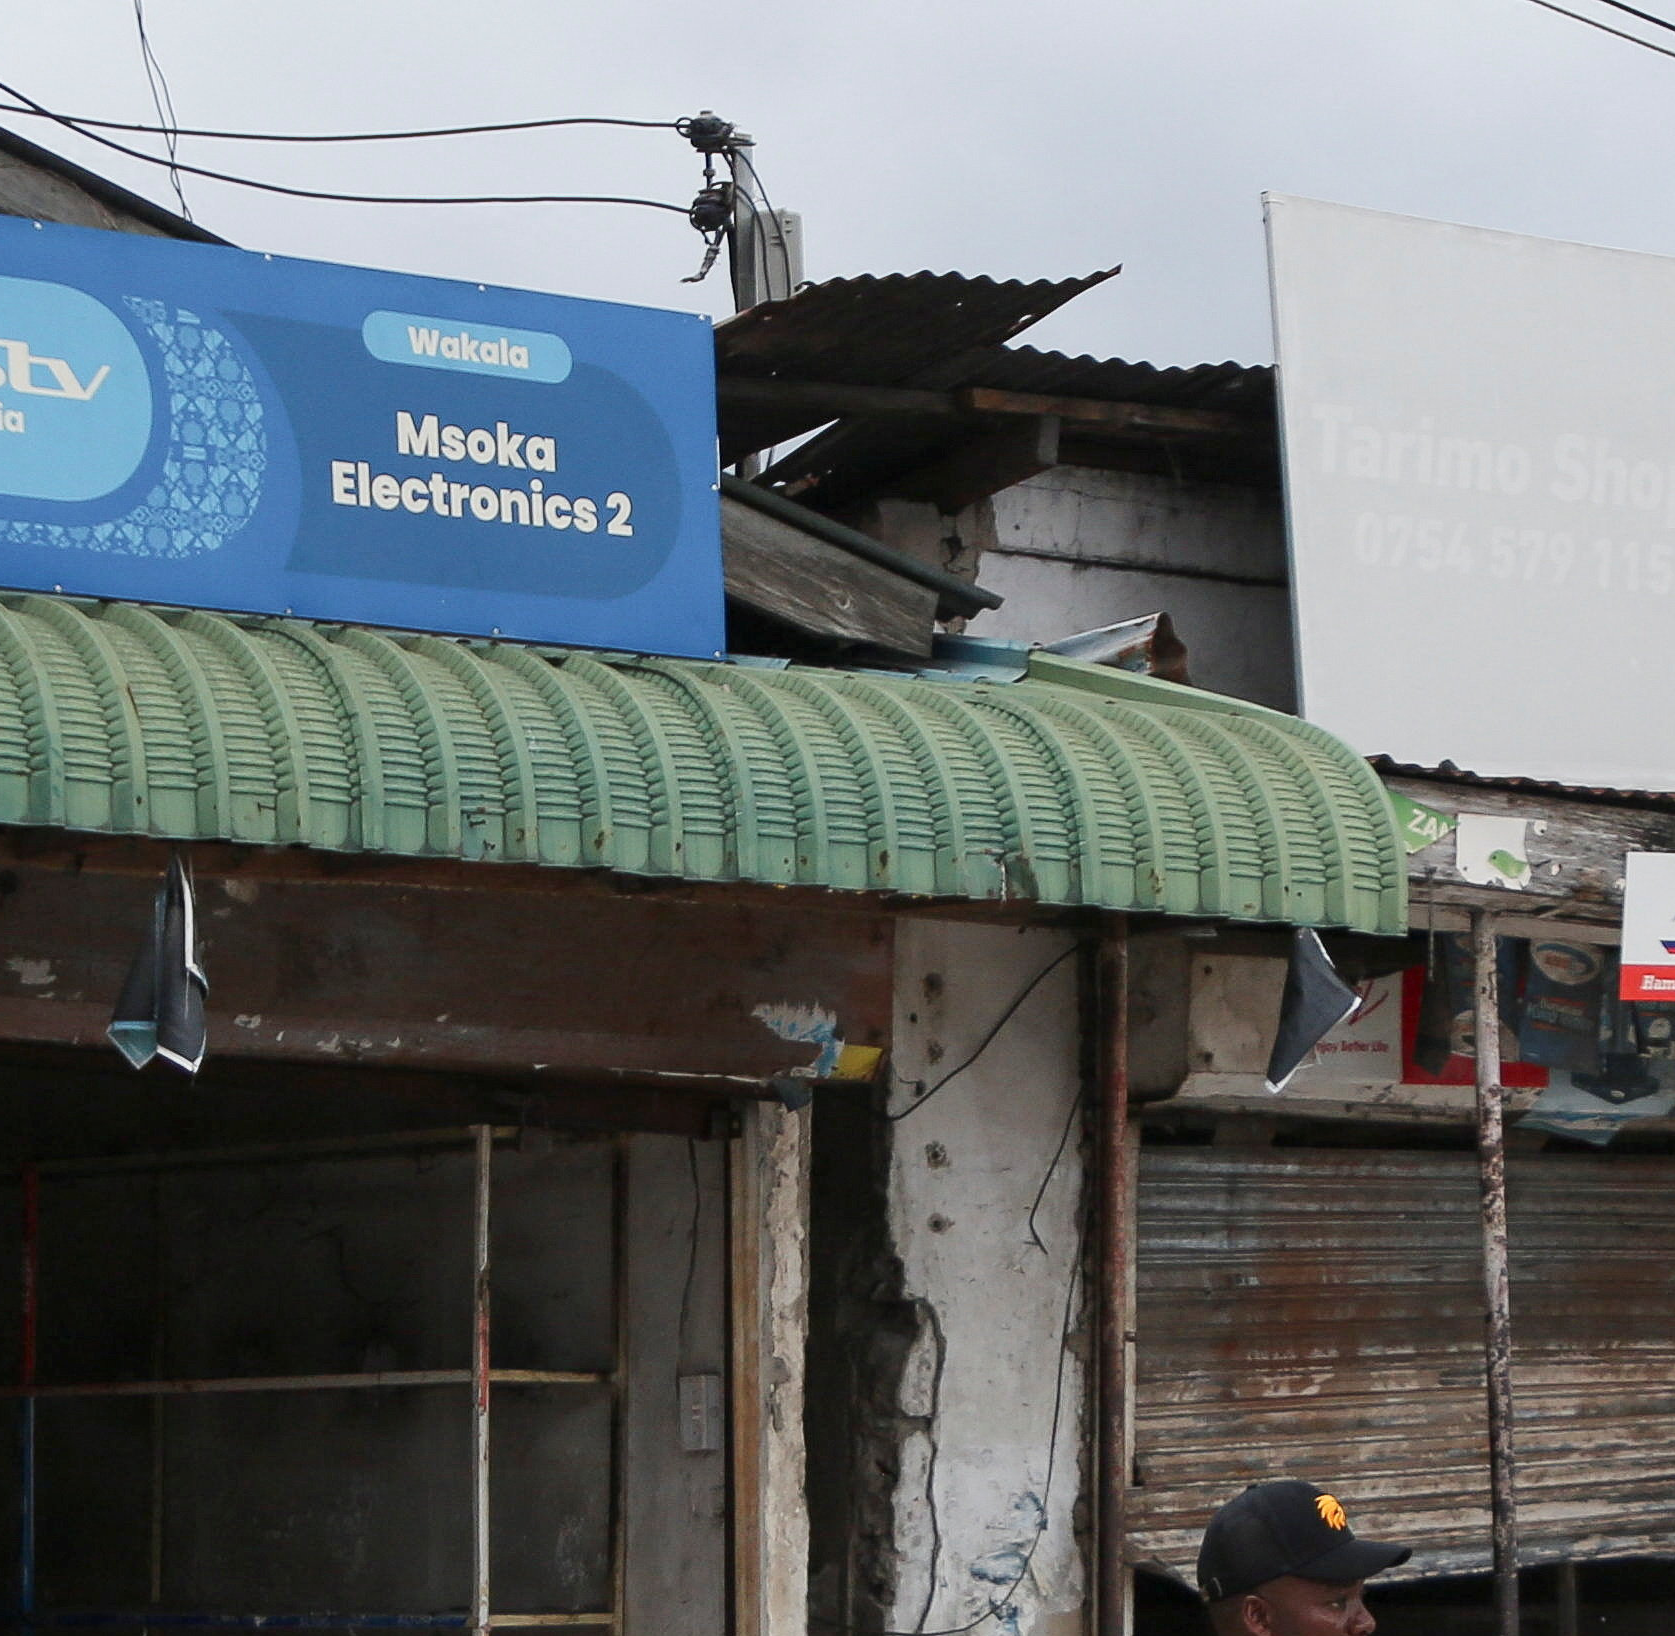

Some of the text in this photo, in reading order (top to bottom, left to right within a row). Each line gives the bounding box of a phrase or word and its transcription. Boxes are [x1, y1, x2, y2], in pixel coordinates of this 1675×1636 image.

[407, 325, 529, 369] Wakala
[396, 411, 556, 472] Msoka
[1311, 403, 1531, 497] Tarimo
[331, 460, 634, 537] Electronics 2
[1355, 511, 1470, 575] 0754
